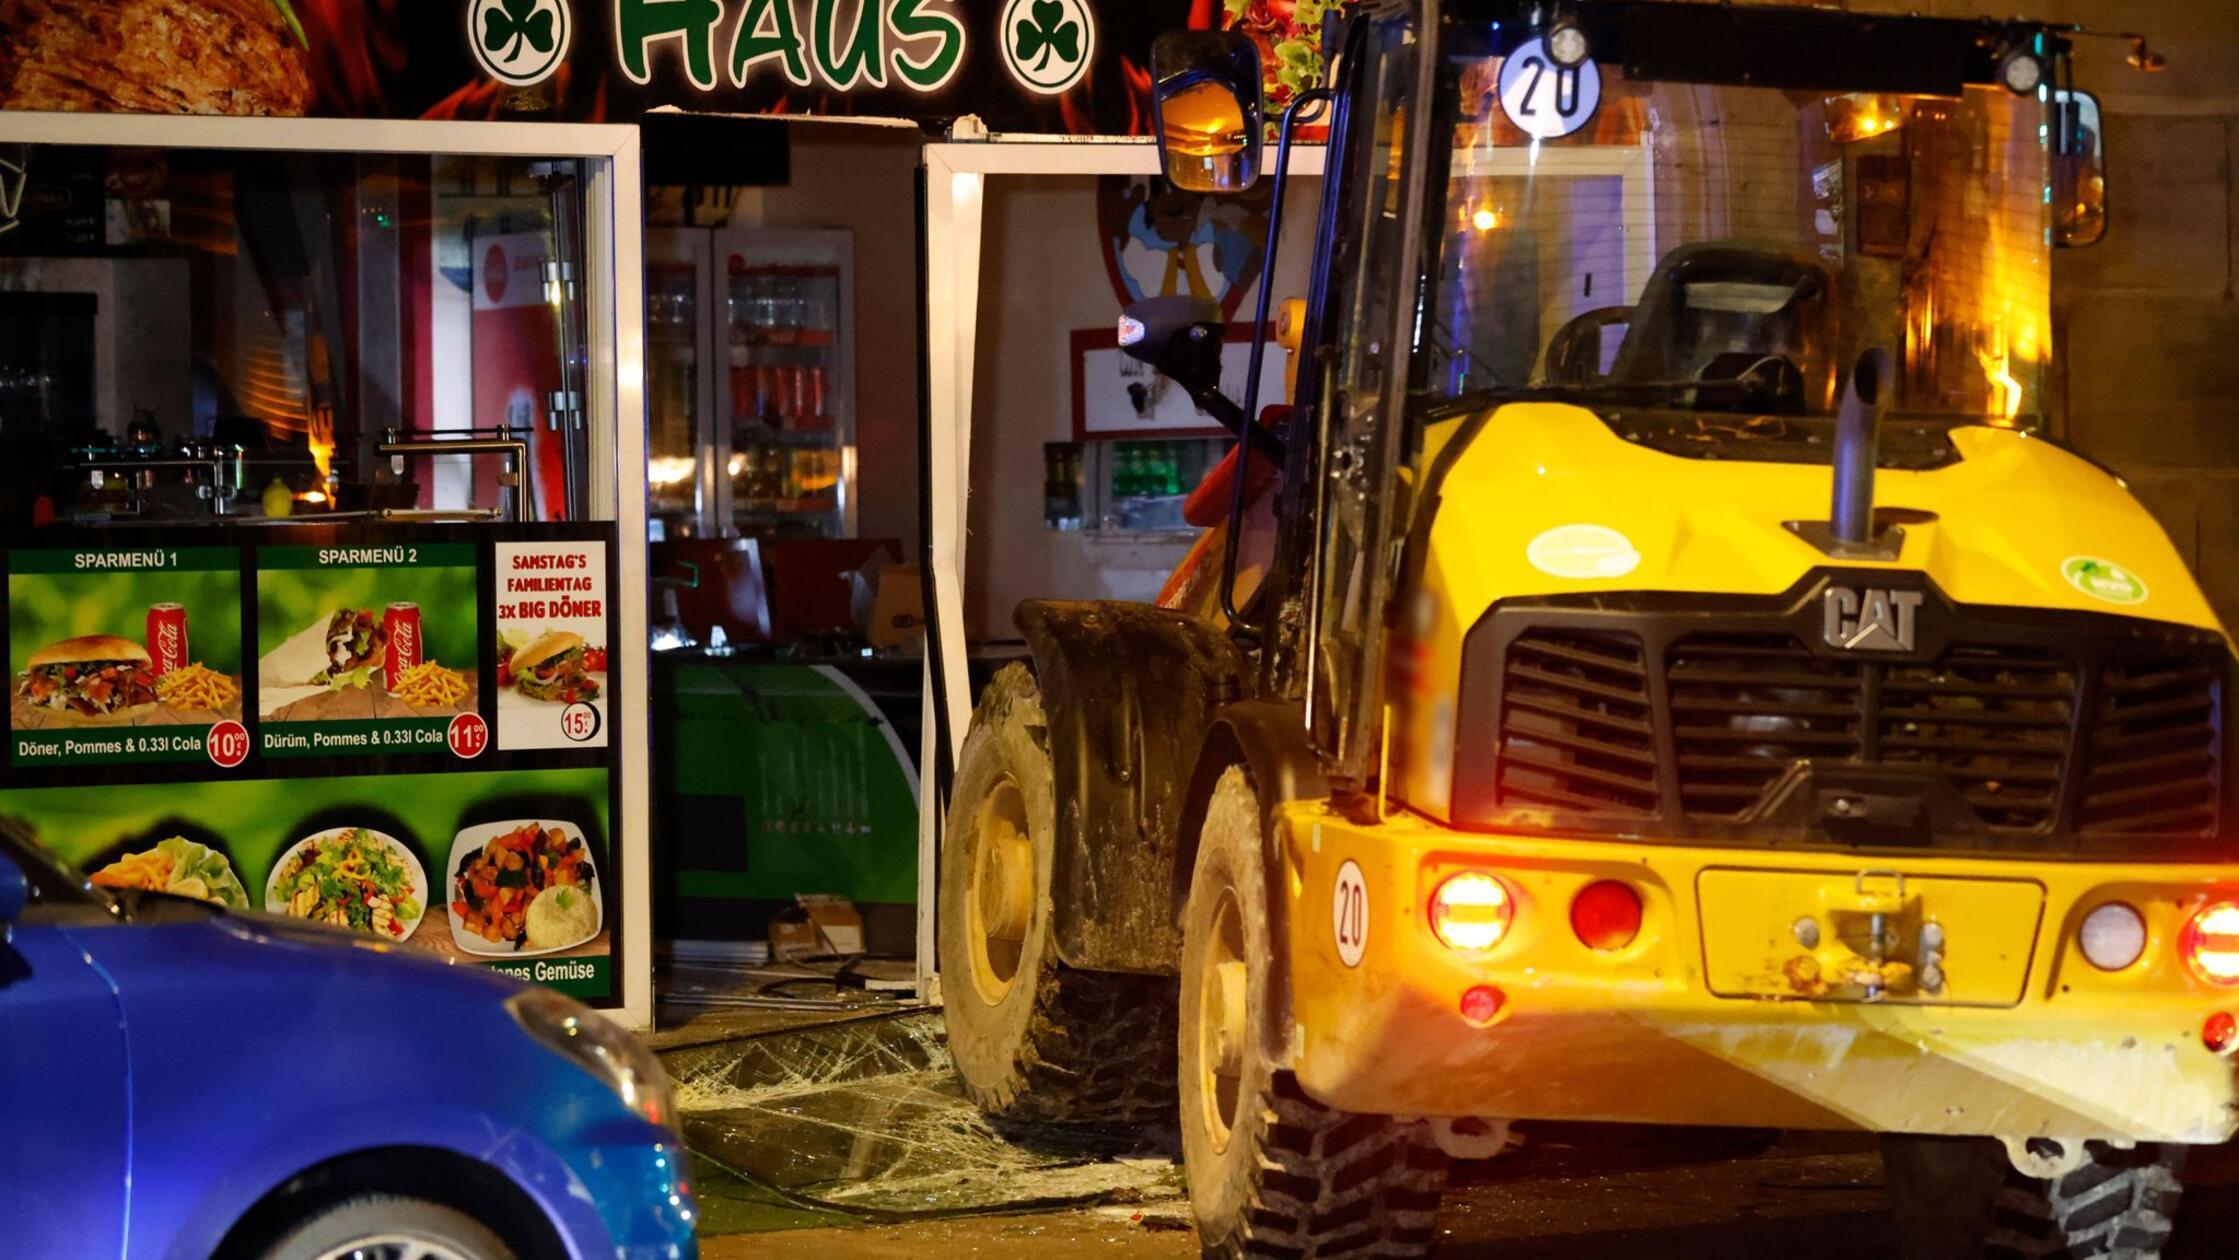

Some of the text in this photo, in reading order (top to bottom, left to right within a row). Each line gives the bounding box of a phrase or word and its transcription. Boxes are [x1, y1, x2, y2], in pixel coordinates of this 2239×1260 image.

[614, 0, 967, 92] HAUS
[1520, 56, 1581, 118] 20
[74, 549, 177, 568] SPARMENÜ 1
[319, 545, 417, 564] SPARMENÜ 2
[507, 576, 592, 592] FAMILIENTAG
[519, 601, 546, 619] BIG
[549, 595, 602, 618] DÖNER
[1823, 586, 1924, 652] CAT
[19, 741, 62, 757] Döner,
[65, 740, 122, 754] Pommes
[126, 737, 135, 752] &
[172, 736, 201, 751] Cola
[264, 733, 311, 749] Dürüm,
[314, 732, 368, 747] Pommes
[371, 730, 381, 744] &
[415, 729, 443, 743] Cola
[1340, 880, 1362, 948] 20
[535, 960, 595, 981] Gemüse
